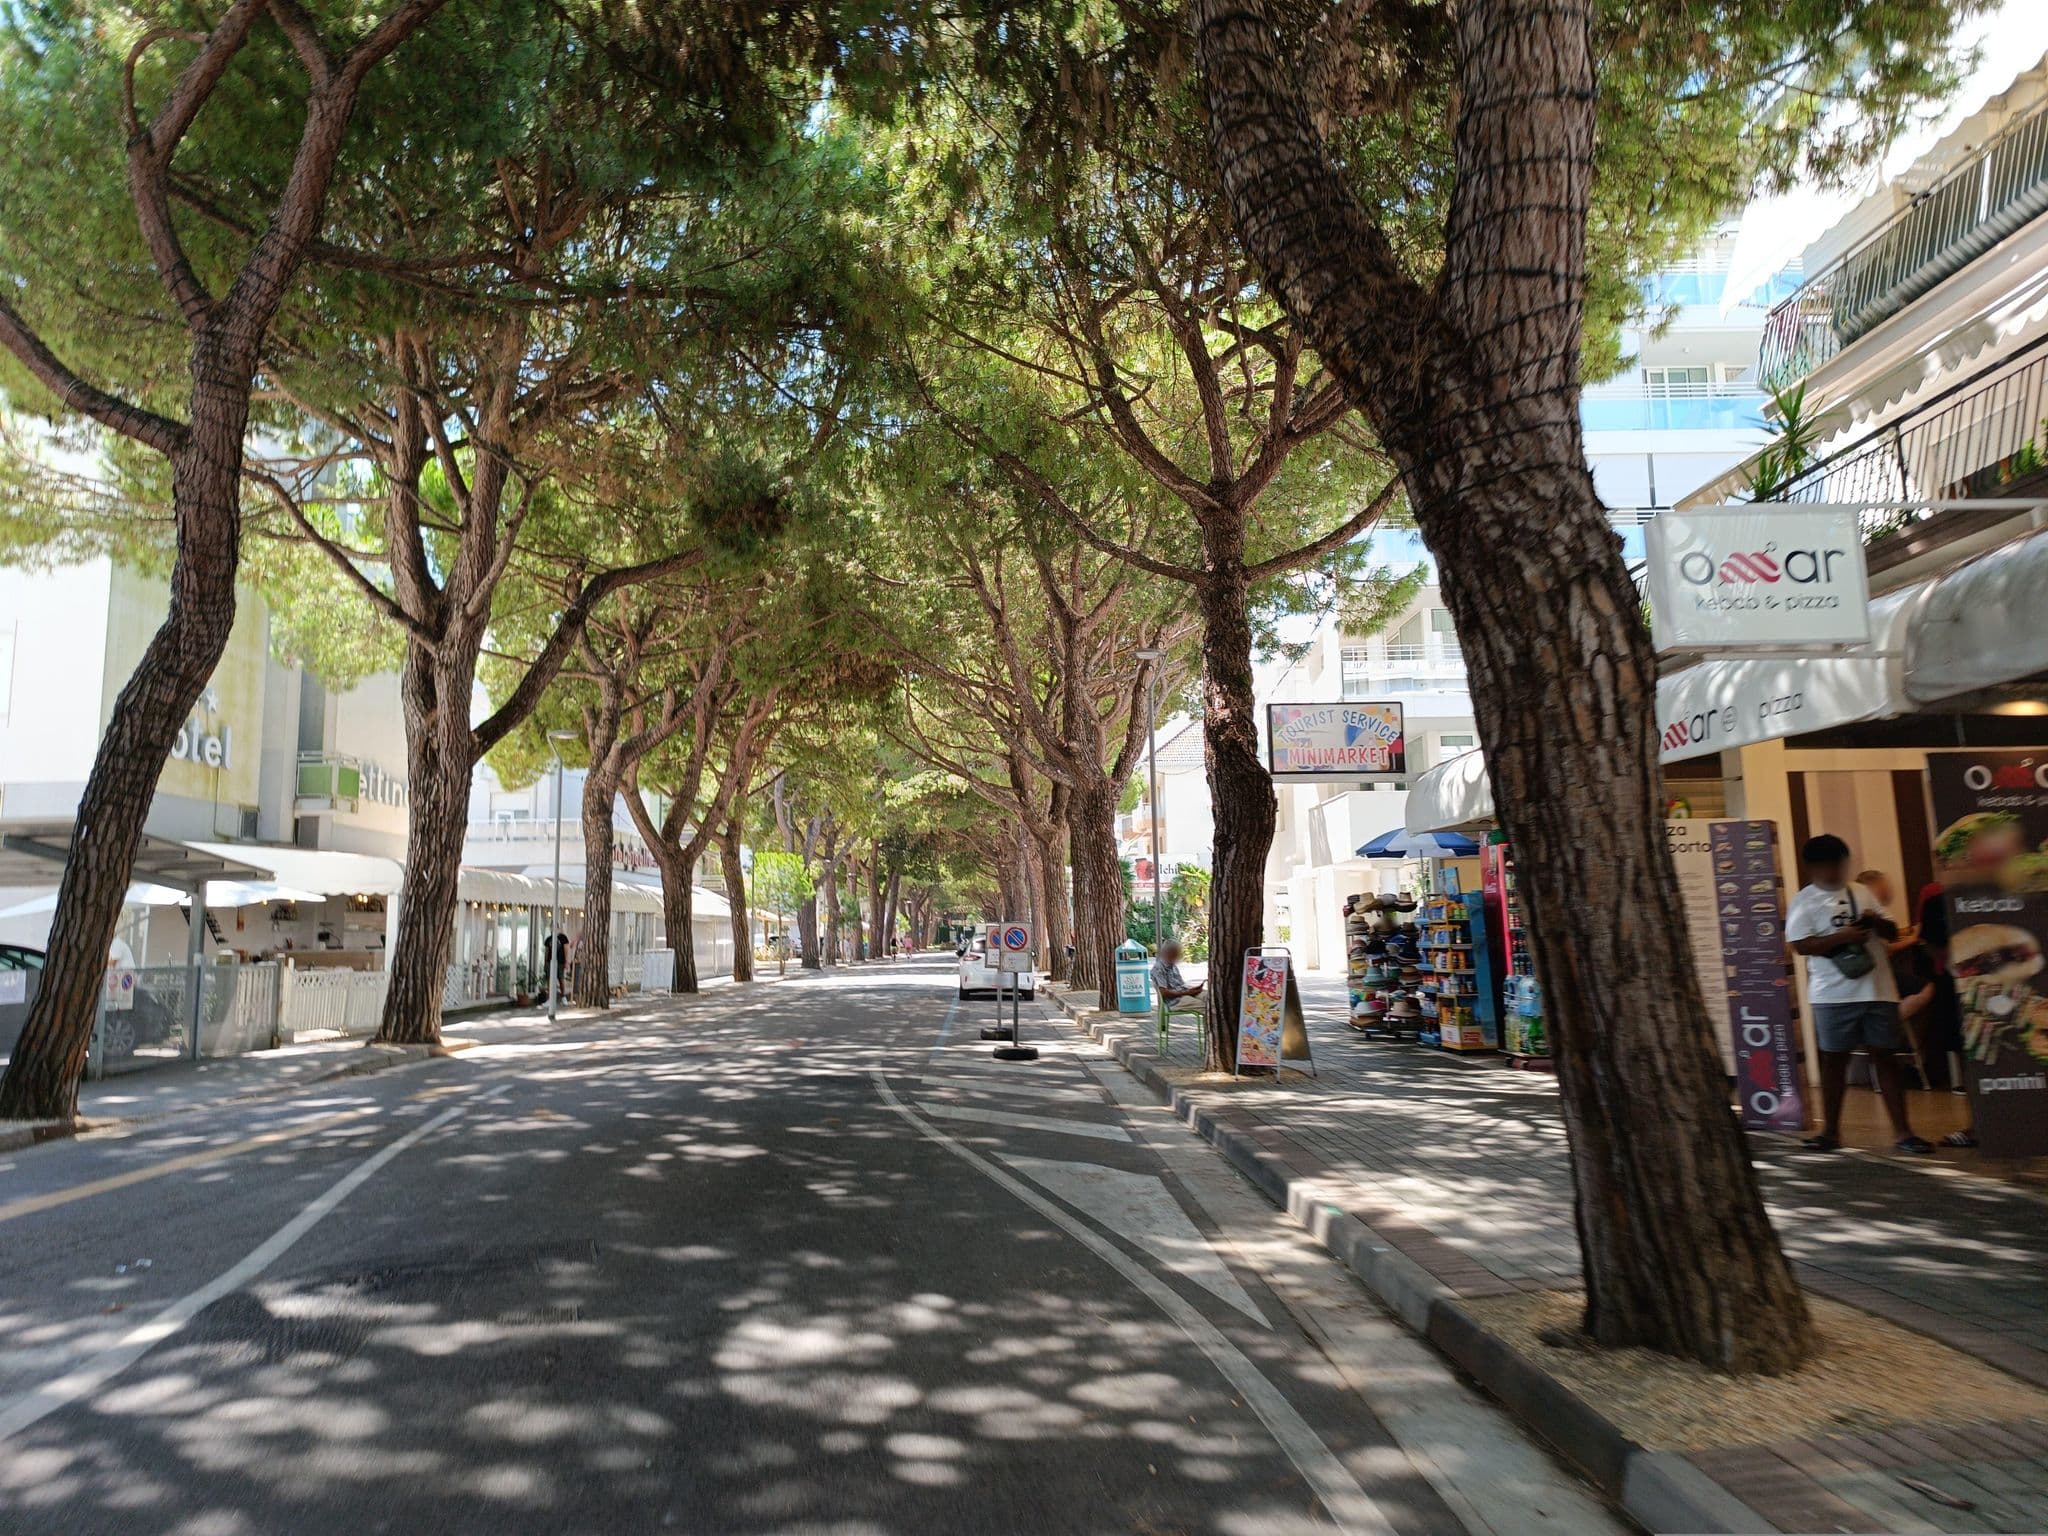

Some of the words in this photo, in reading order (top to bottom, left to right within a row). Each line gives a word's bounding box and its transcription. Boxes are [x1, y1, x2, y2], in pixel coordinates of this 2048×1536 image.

[1765, 594, 1780, 610] &
[1785, 594, 1839, 613] pizza
[1279, 710, 1335, 744] TOURIST
[1341, 710, 1398, 744] SERVICE
[170, 717, 233, 769] otel
[1288, 746, 1388, 765] MINIMARKET
[1955, 897, 2025, 913] kebab
[1979, 1073, 2048, 1095] panini
